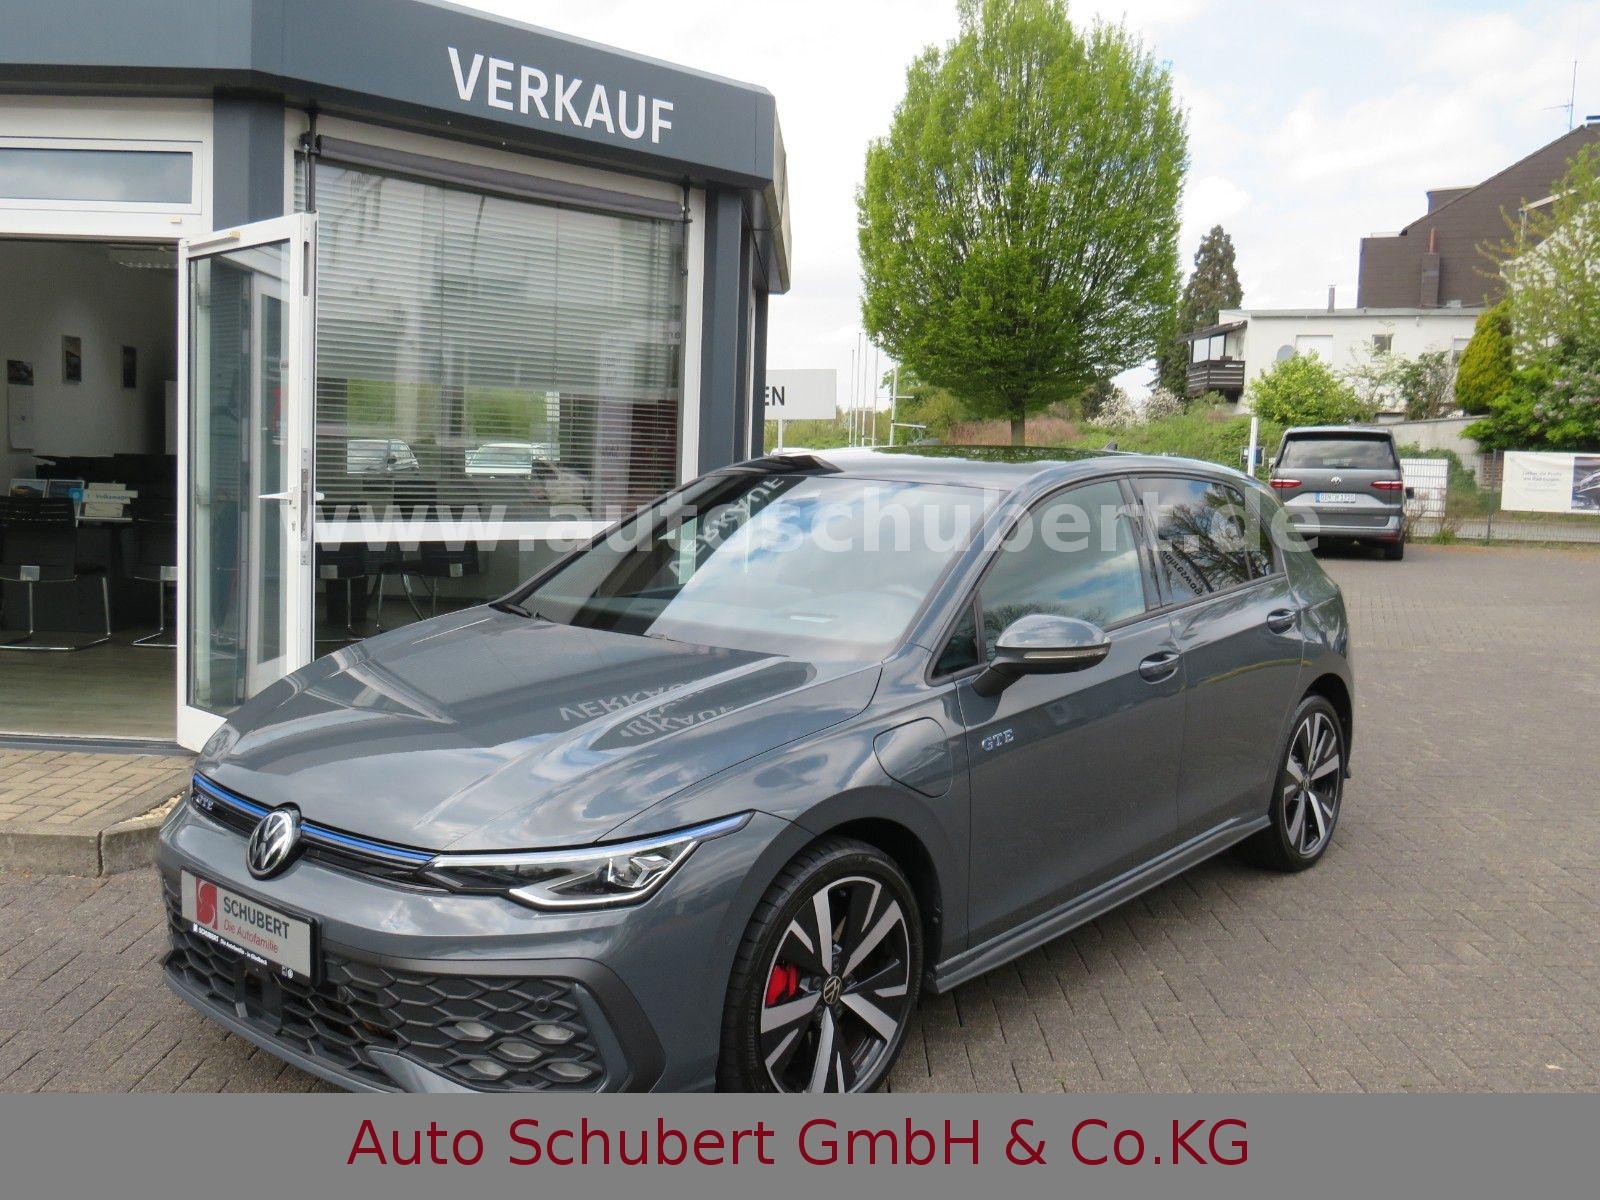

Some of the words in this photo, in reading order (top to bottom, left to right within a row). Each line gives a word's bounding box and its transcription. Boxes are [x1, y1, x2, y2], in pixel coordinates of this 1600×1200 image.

[447, 47, 675, 145] VERKAUF
[981, 728, 1015, 752] GTE
[223, 896, 290, 939] SCHUBERT
[236, 930, 279, 954] Autofamilie
